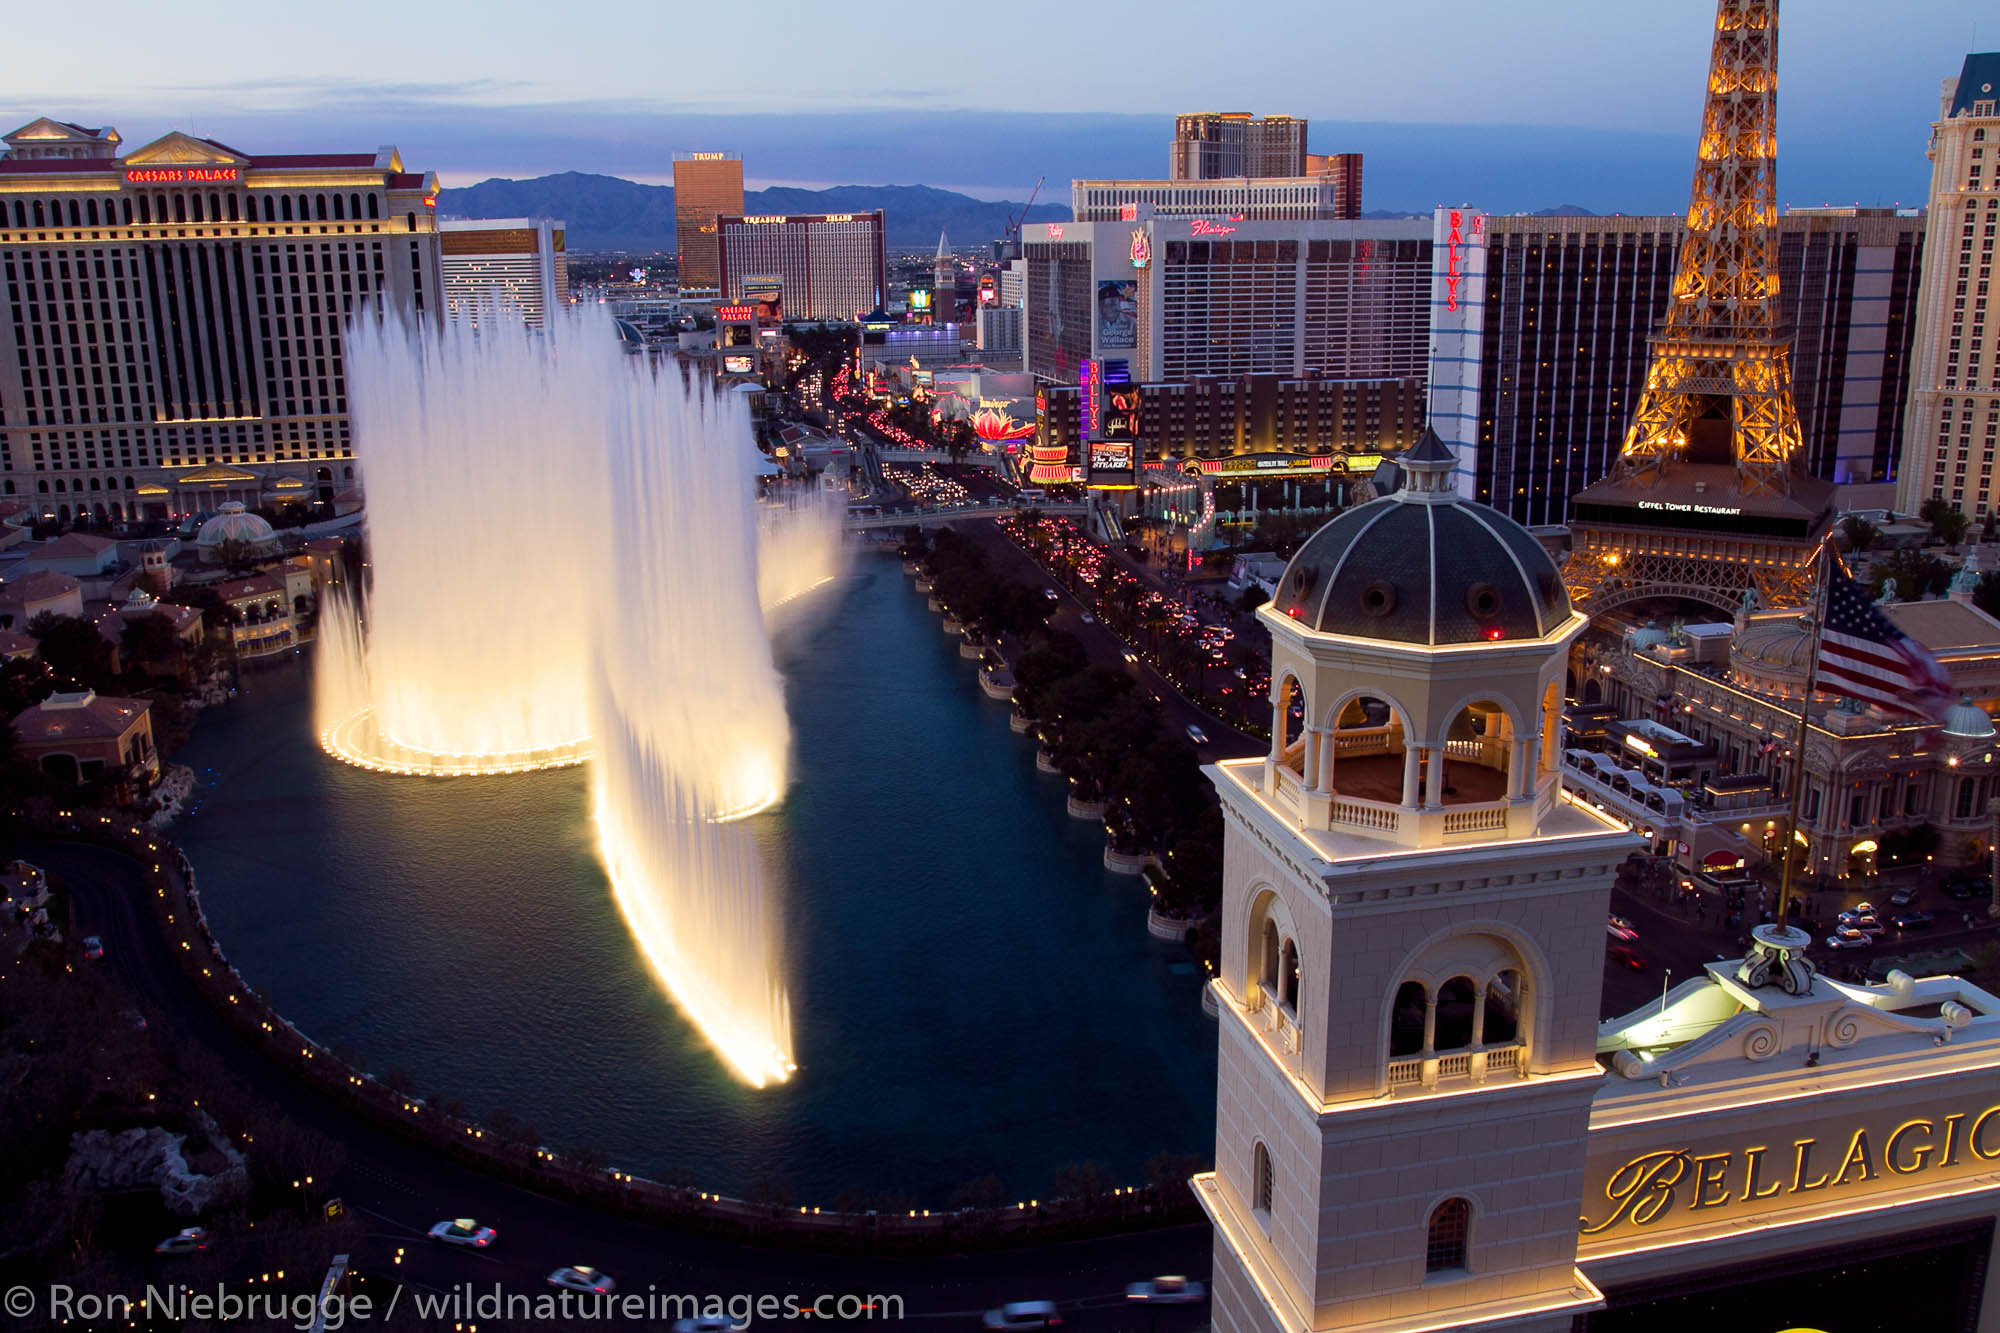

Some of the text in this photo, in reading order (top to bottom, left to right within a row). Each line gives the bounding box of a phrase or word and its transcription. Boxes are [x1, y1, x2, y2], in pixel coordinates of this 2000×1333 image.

[693, 152, 724, 161] TRUMP
[126, 168, 238, 183] CAESARS PALACE
[743, 214, 853, 224] TREASURE ISLAND
[1190, 218, 1237, 238] Flamingo
[719, 306, 753, 314] CAESARS
[720, 313, 752, 321] PALACE
[1103, 328, 1133, 338] George
[1101, 336, 1134, 344] Wallace
[1088, 361, 1099, 431] BALLYS
[1638, 501, 1741, 515] EIFFEL TOWER RESTAURANT
